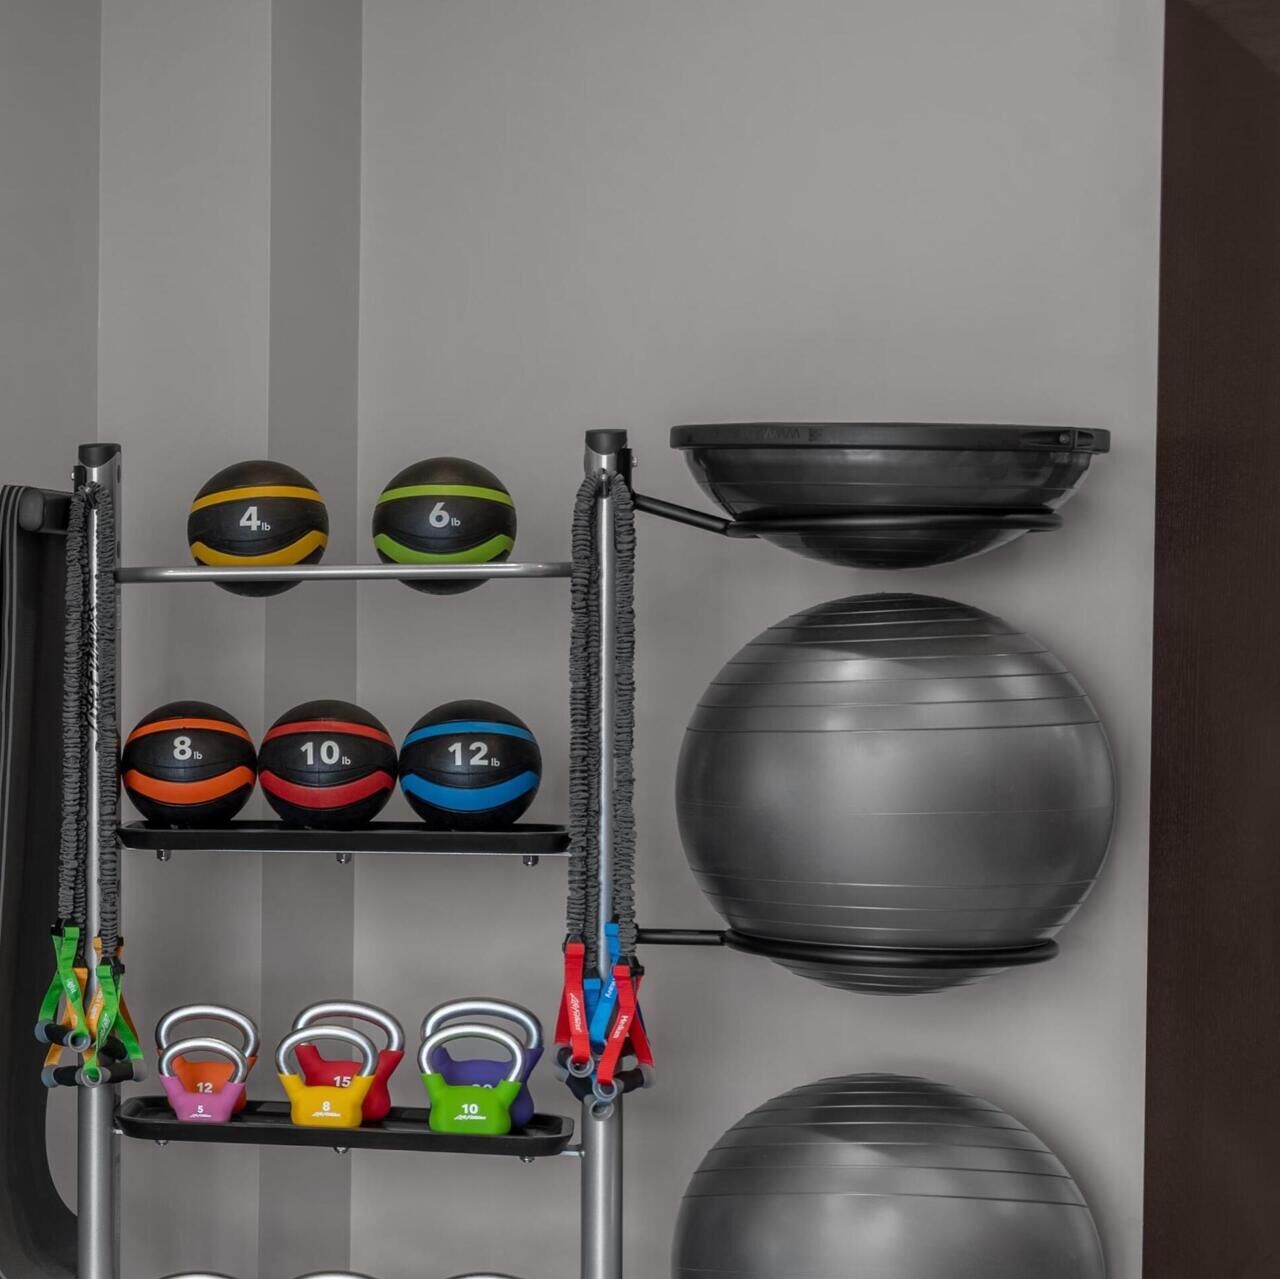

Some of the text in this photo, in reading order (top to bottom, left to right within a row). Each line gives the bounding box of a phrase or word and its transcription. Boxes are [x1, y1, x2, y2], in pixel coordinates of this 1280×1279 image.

[196, 1081, 213, 1094] 12
[333, 1075, 352, 1088] 15
[196, 1104, 205, 1114] 5
[321, 1100, 332, 1112] 8
[461, 1103, 479, 1115] 10
